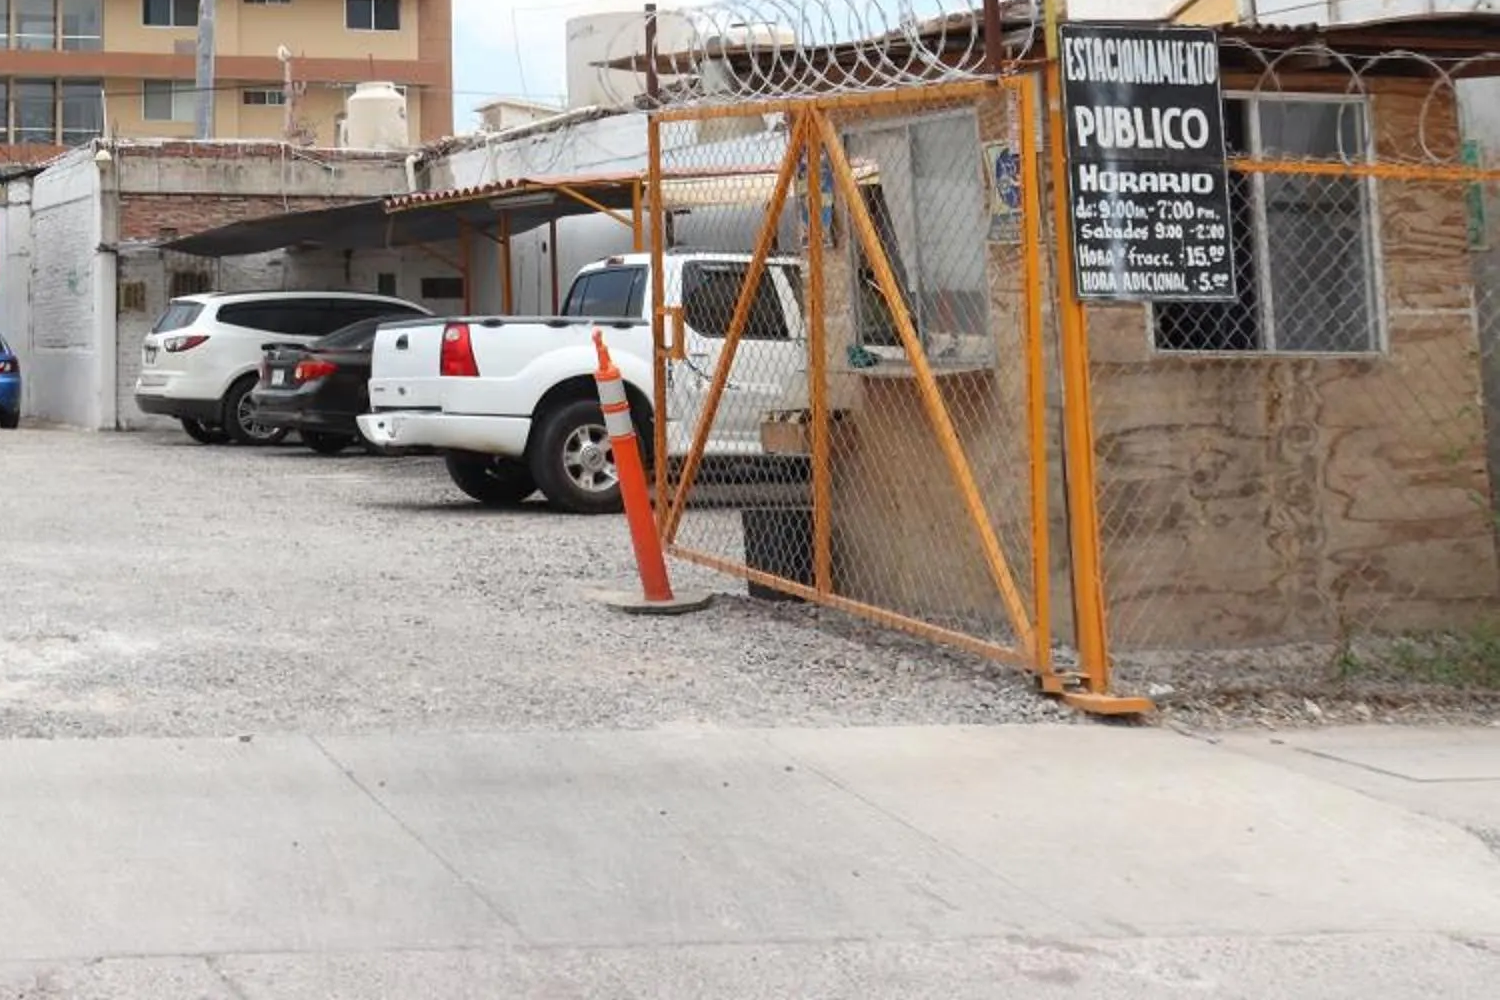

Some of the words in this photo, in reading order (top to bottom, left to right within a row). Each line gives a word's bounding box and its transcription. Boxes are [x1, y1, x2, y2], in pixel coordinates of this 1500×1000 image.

[1065, 37, 1217, 86] ESTACIONAMIENTO
[1074, 105, 1210, 149] PUBLICO
[1079, 164, 1215, 193] HORARIO
